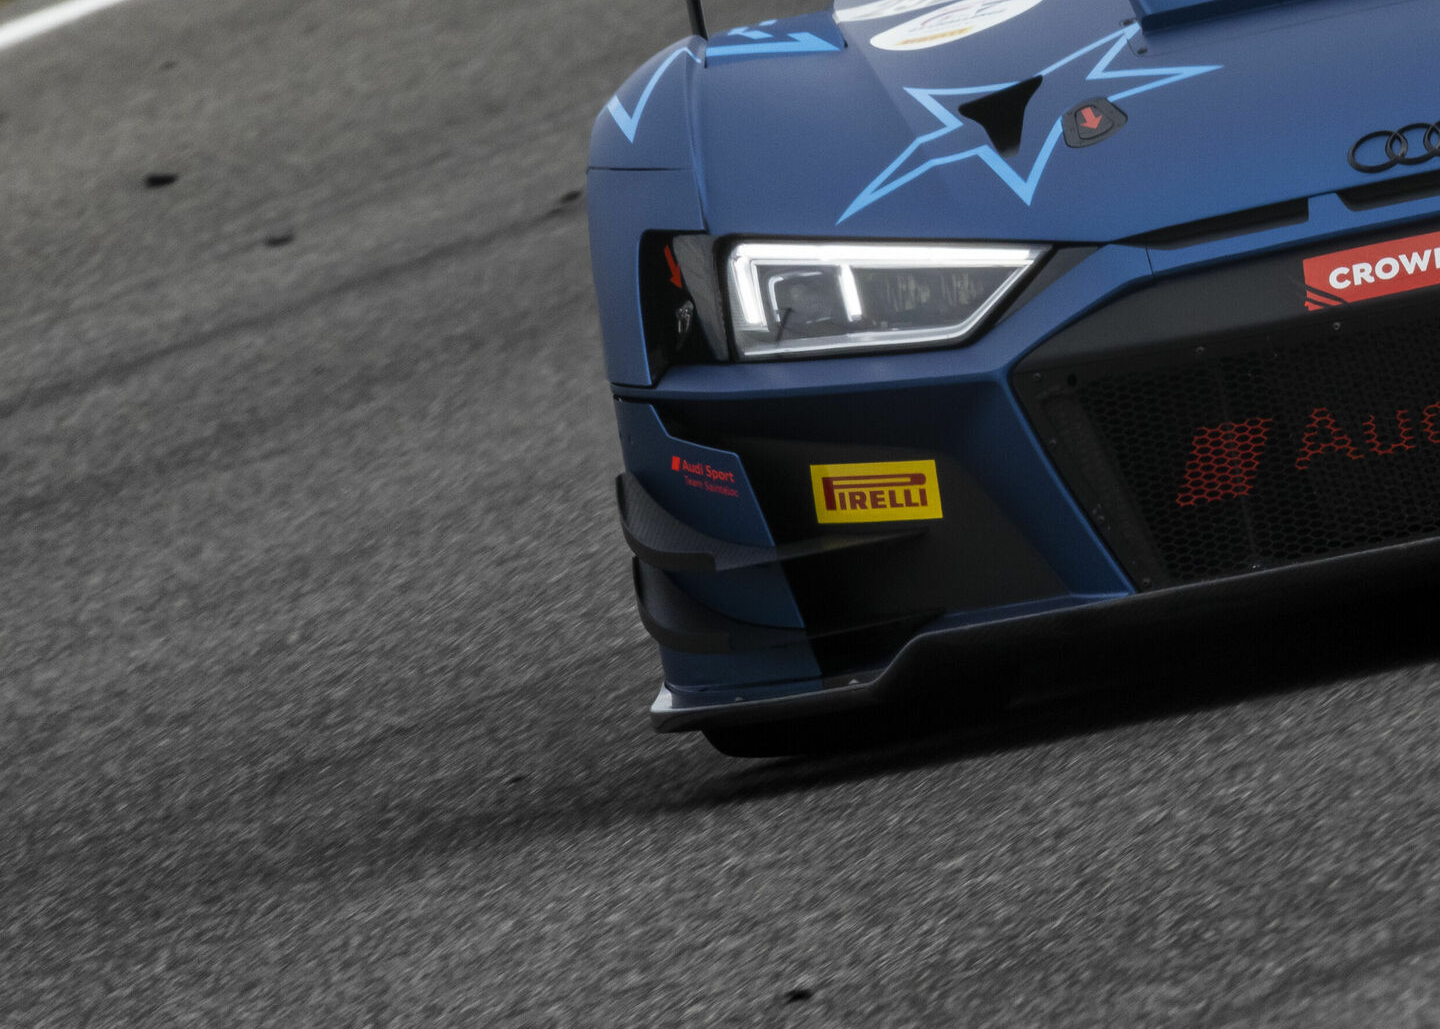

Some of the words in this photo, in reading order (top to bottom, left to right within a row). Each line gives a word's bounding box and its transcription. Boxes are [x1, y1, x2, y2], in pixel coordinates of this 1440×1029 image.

[681, 459, 704, 476] Audi
[704, 464, 736, 483] Sport
[821, 472, 928, 511] PIRELLI
